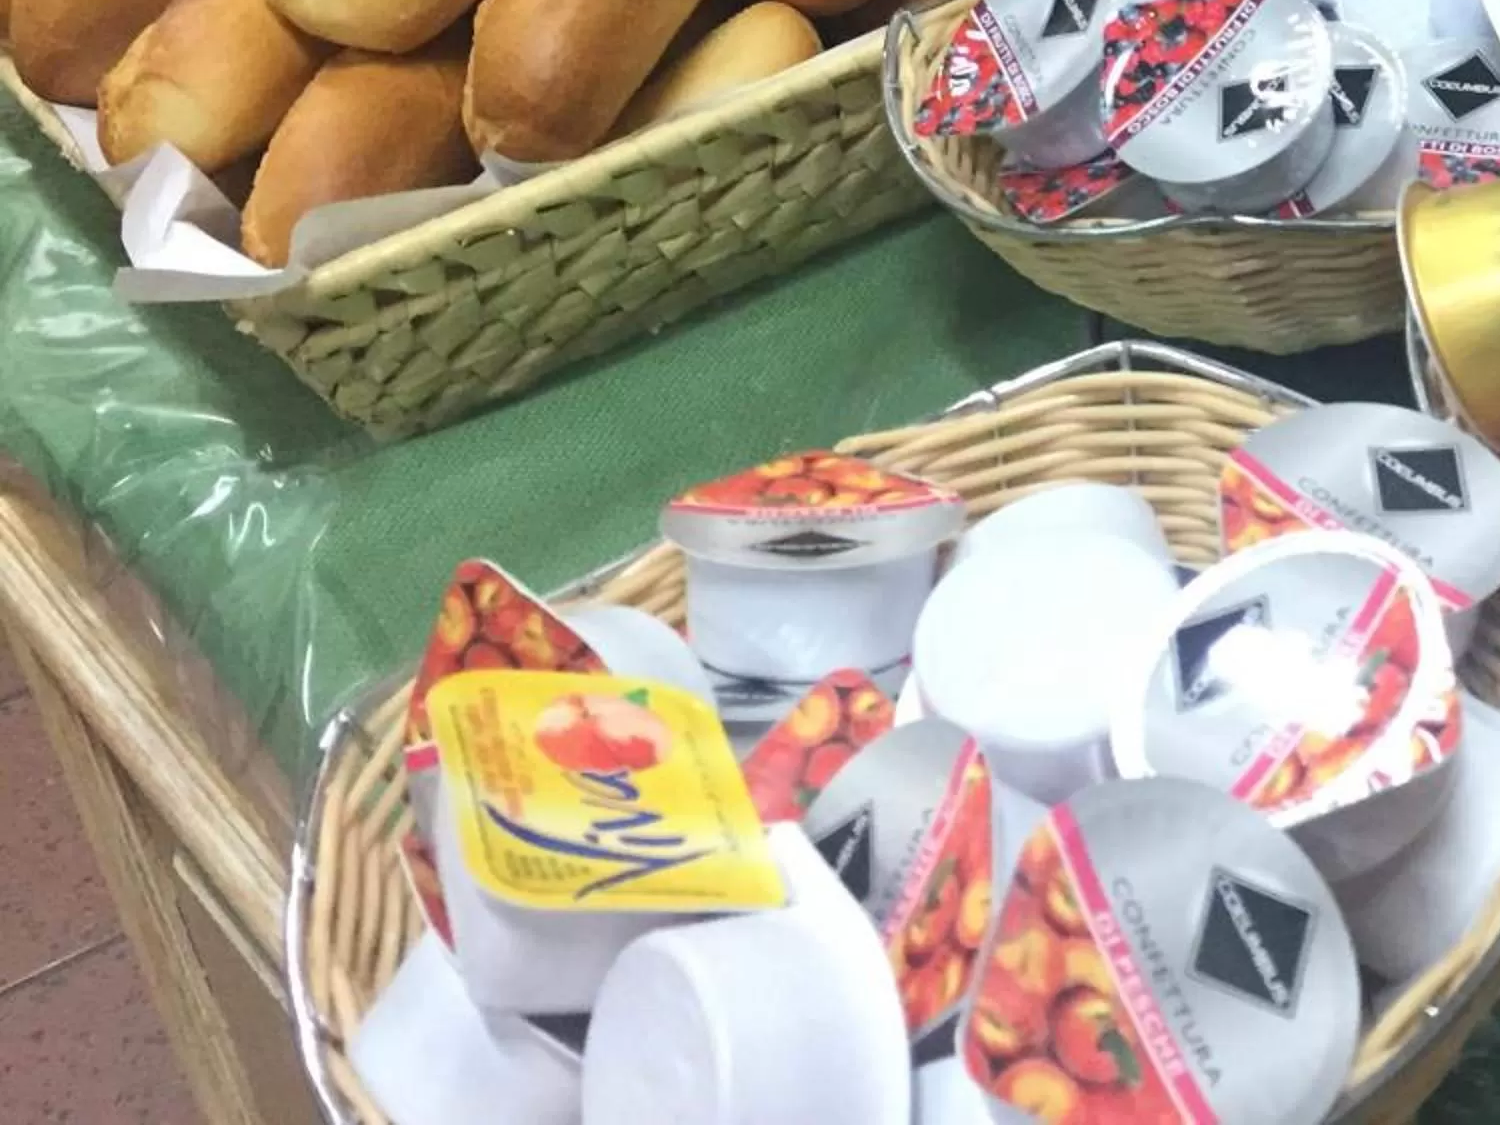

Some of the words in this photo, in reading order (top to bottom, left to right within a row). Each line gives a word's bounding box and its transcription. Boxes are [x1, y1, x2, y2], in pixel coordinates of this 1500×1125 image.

[1193, 19, 1242, 71] FRUTTI
[1239, 0, 1257, 18] DI
[1127, 84, 1175, 135] BOSCO
[1160, 27, 1257, 130] CONFETTURA
[1176, 70, 1193, 87] DI
[1299, 475, 1434, 569] CONFETTURA
[481, 771, 717, 901] Viva
[1091, 909, 1124, 948] DI
[1108, 952, 1190, 1078] PESCHE
[1102, 874, 1235, 1086] CONFETTURA
